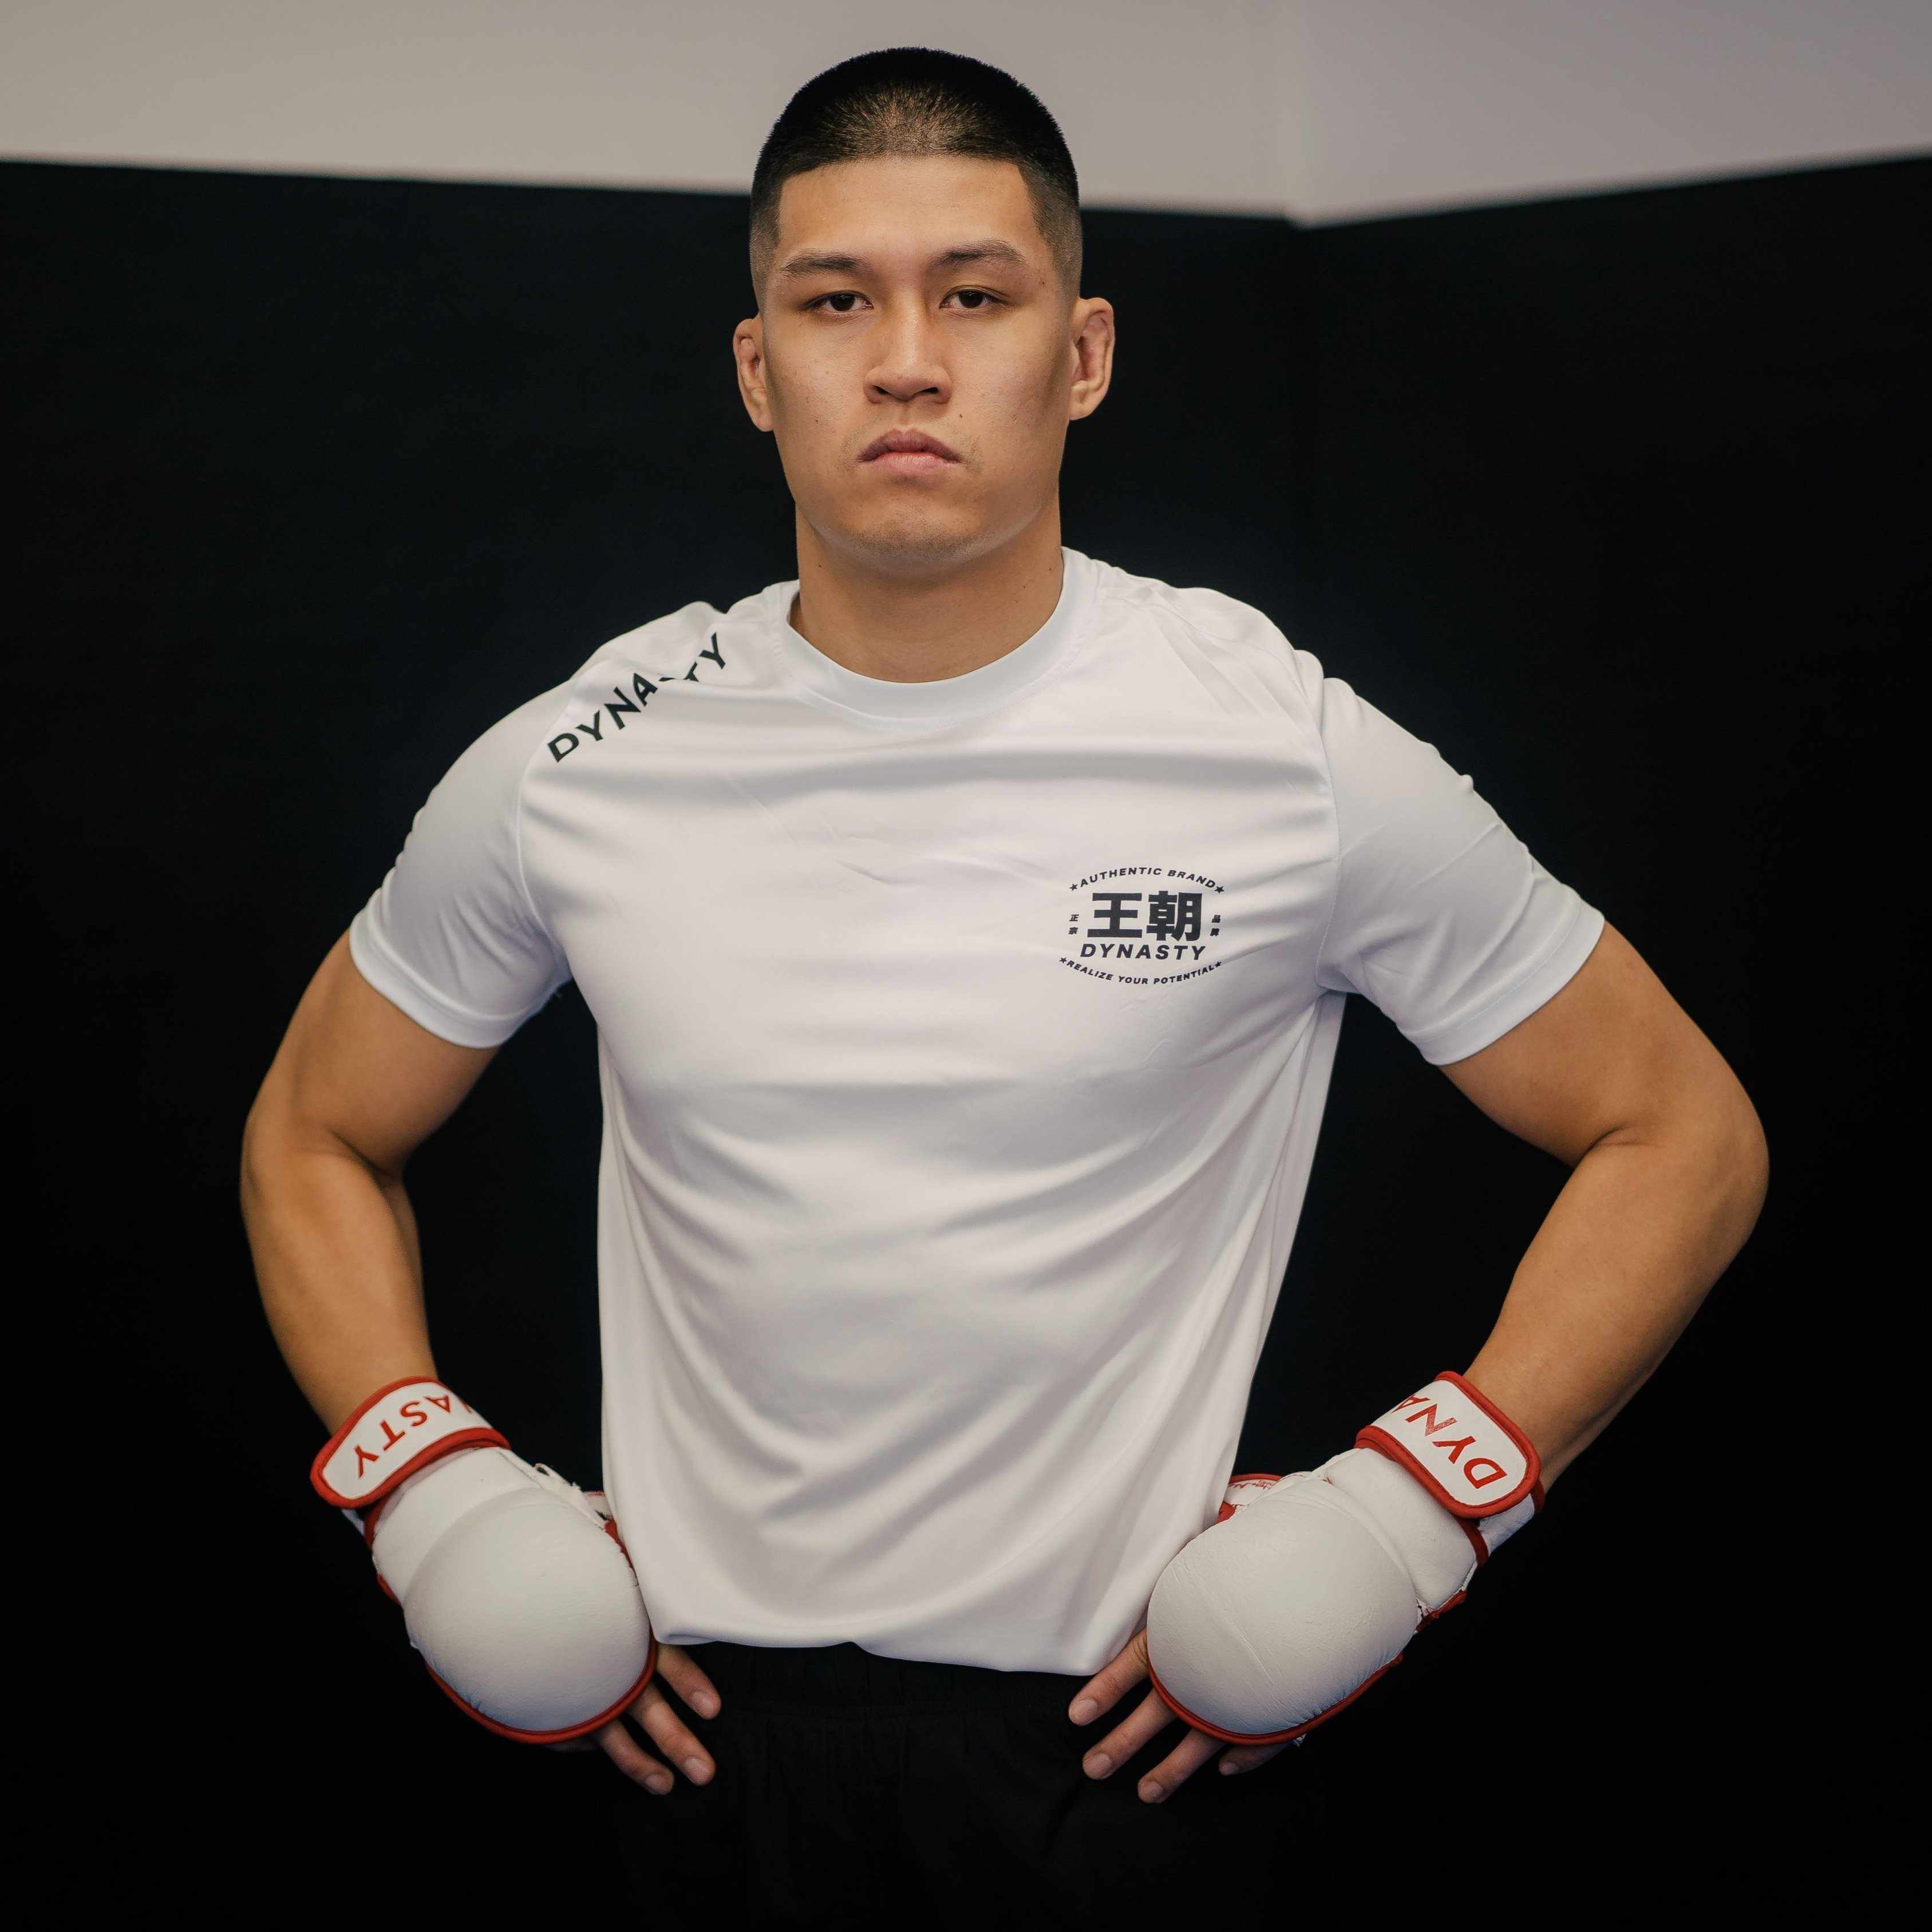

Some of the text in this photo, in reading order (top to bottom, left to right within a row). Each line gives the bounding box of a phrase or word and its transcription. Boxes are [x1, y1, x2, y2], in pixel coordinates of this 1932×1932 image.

[547, 631, 726, 763] DYNATY
[1080, 867, 1216, 888] AUTHENTIC BRAND
[1068, 914, 1080, 935] 正宗
[1086, 890, 1203, 942] 王朝
[1080, 943, 1206, 961] DYNASTY
[1066, 960, 1215, 985] REALIZE YOUR POTENTIAL
[353, 1394, 472, 1479] ASTY
